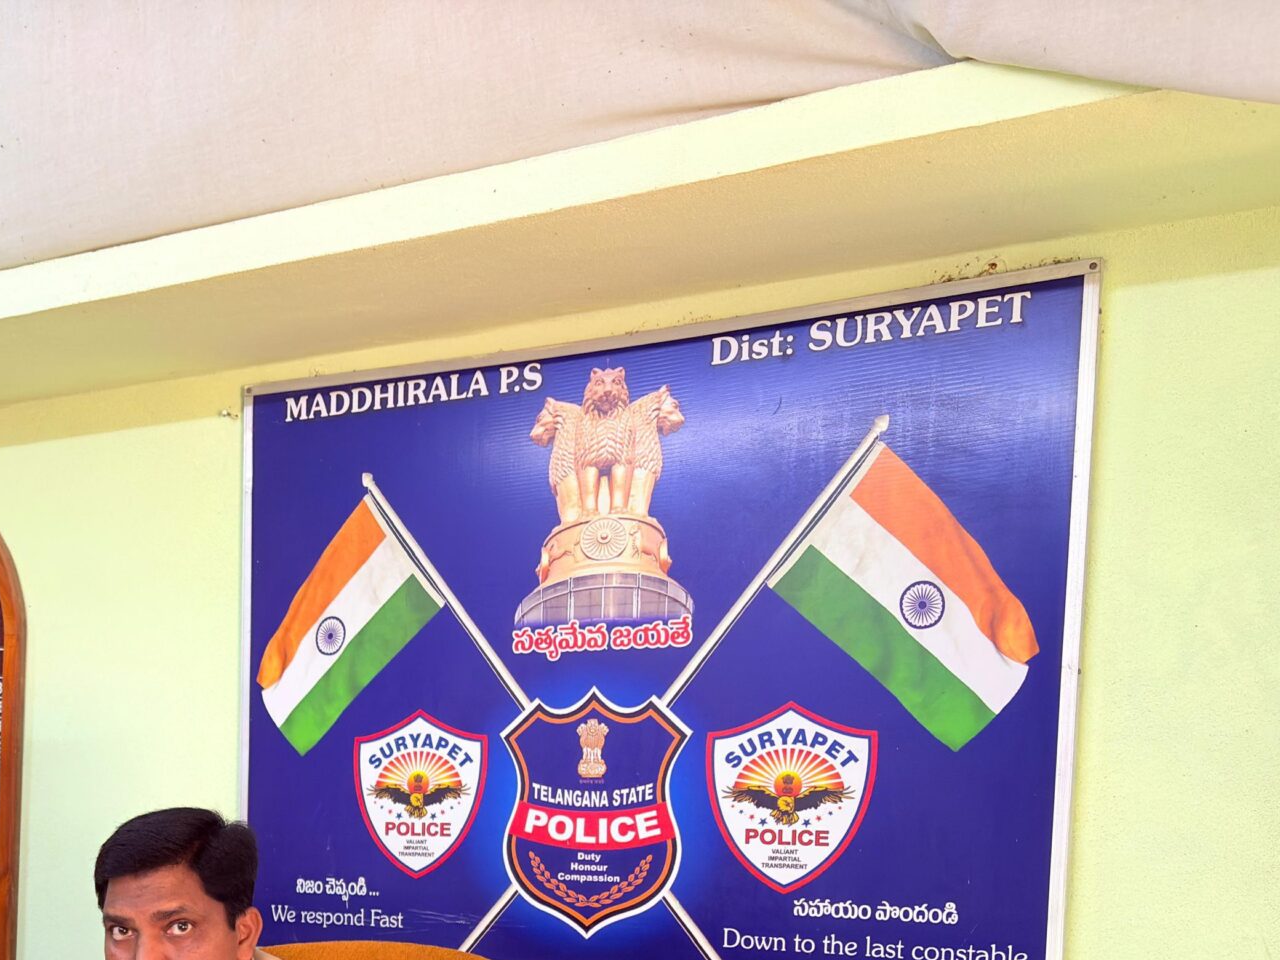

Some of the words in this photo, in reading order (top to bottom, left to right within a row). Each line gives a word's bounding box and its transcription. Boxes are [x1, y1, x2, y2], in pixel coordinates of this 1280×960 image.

[710, 330, 795, 366] Dist:
[808, 291, 1032, 351] SURYAPET
[285, 370, 489, 422] MADDHIRALA
[499, 362, 542, 394] P.S
[513, 619, 607, 661] సత్యమేవ
[612, 615, 692, 649] జయతే
[368, 733, 474, 769] SURYAPET
[725, 728, 859, 769] SURYAPET
[532, 782, 609, 808] TELANGANA
[612, 782, 654, 807] STATE
[385, 822, 451, 837] POLICE
[524, 808, 662, 844] POLICE
[744, 828, 830, 847] POLICE
[570, 862, 608, 872] Honour
[577, 852, 601, 862] Duty
[557, 872, 620, 883] Compassion
[271, 904, 296, 922] We
[301, 908, 365, 928] respond
[370, 908, 404, 928] Fast
[793, 897, 871, 920] సహాయం
[875, 900, 959, 925] పొందండి
[722, 927, 786, 953] Down
[793, 933, 816, 954] to
[822, 934, 858, 957] the
[865, 936, 904, 960] last
